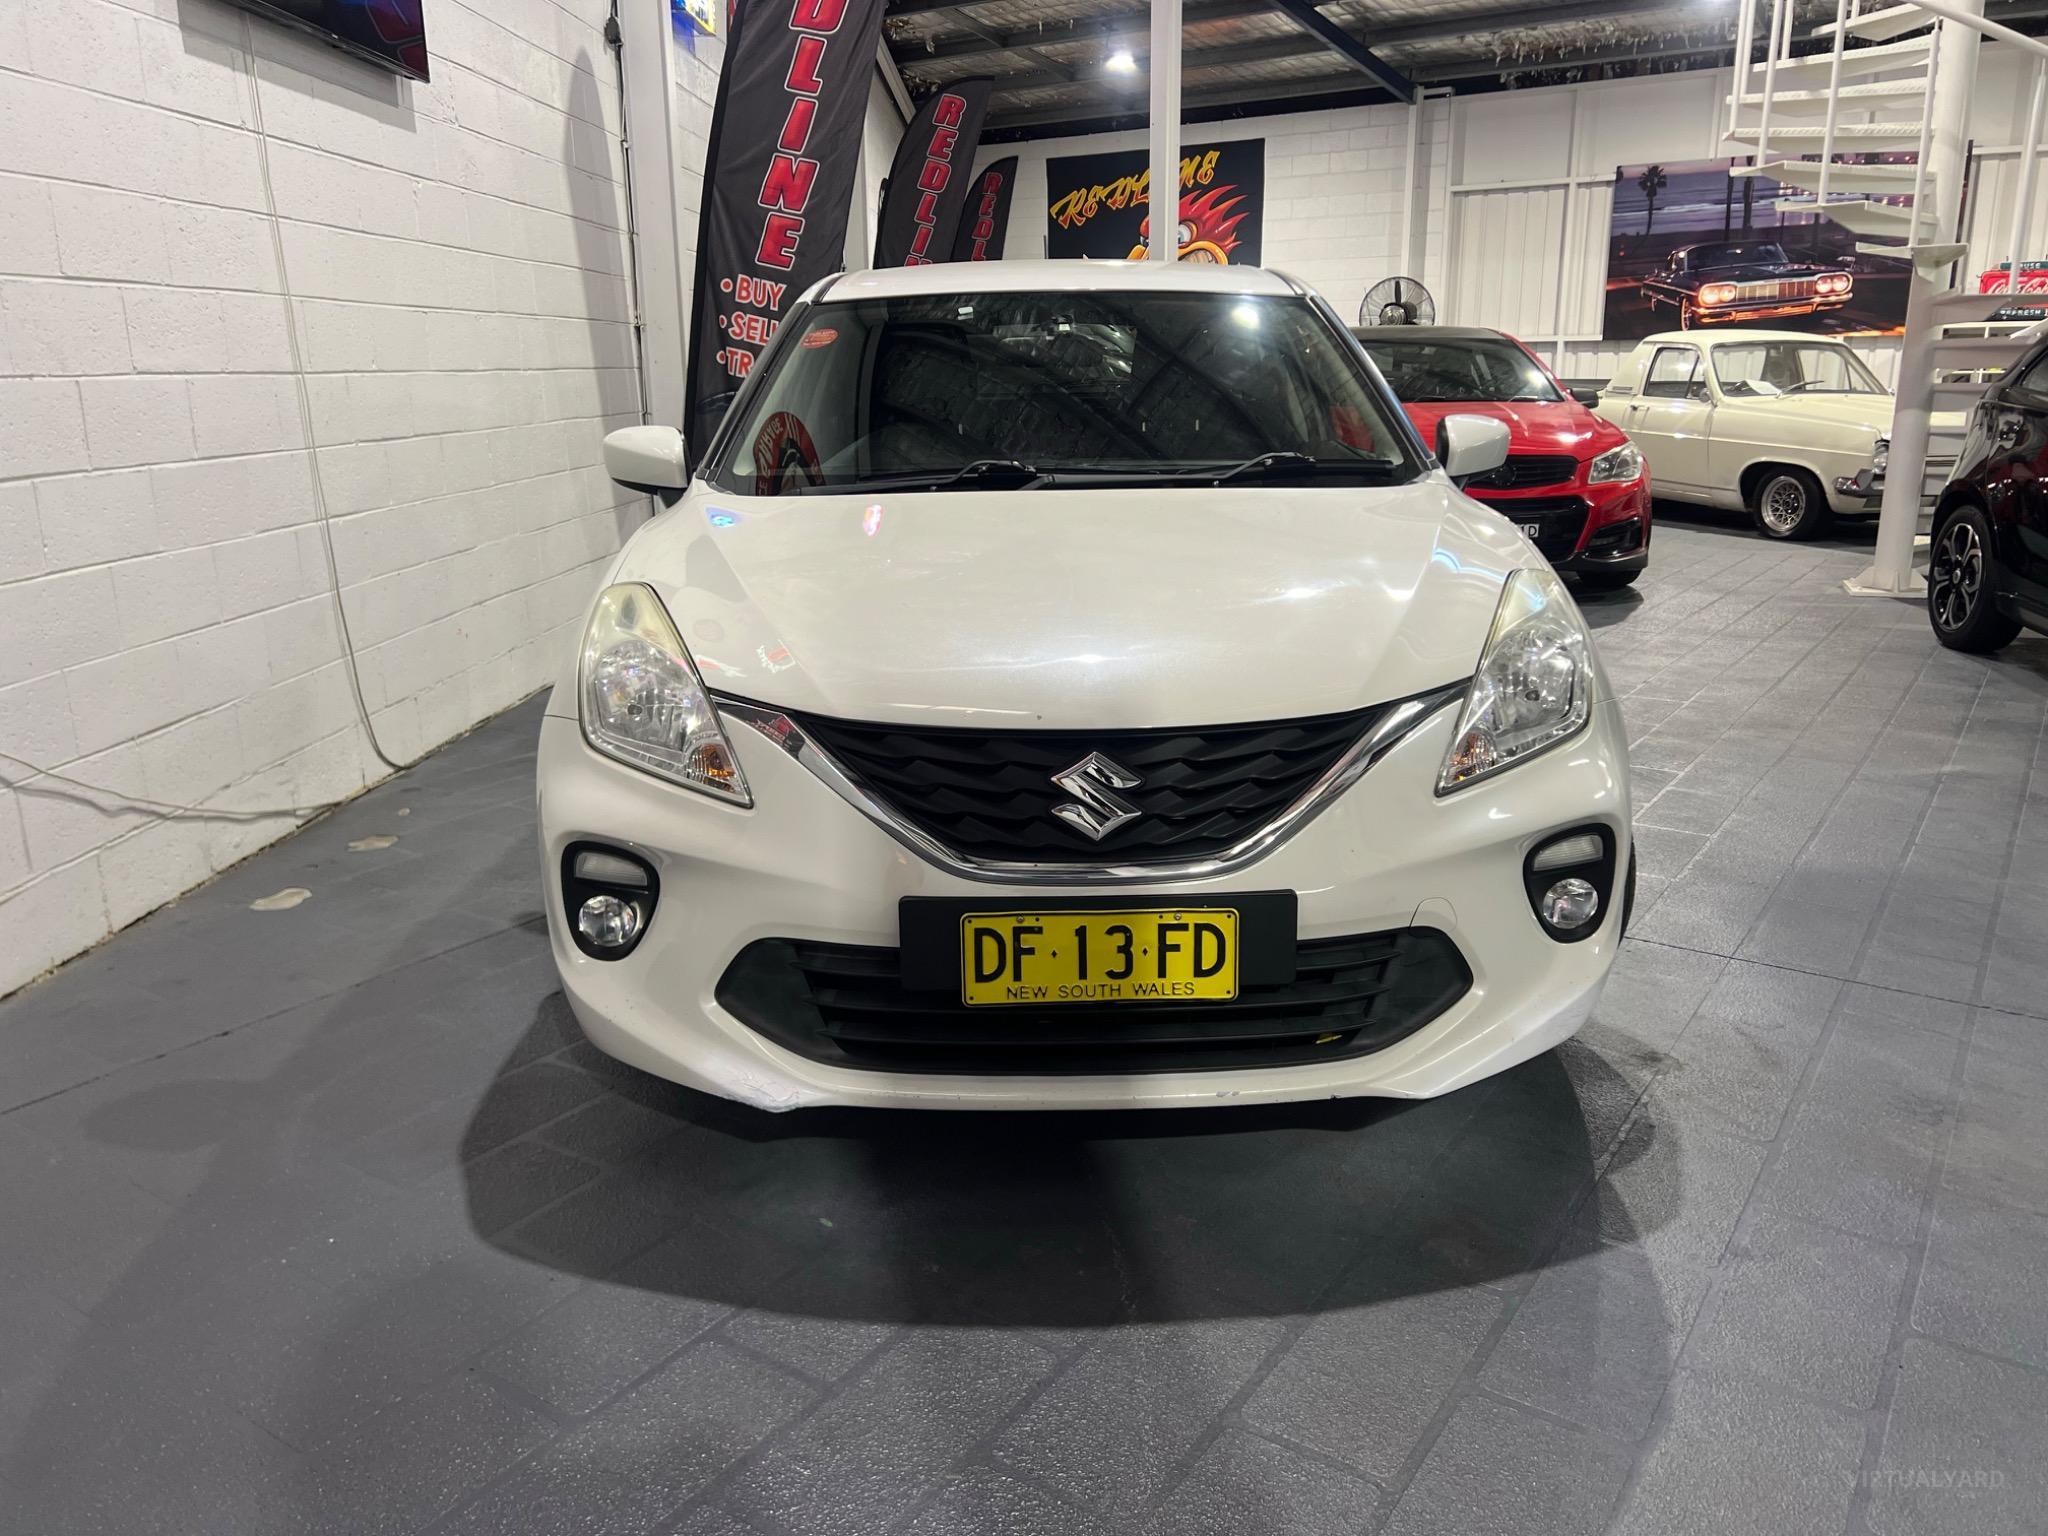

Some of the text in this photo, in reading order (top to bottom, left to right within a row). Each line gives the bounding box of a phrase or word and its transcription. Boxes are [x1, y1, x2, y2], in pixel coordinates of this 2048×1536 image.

[1050, 150, 1221, 229] REDLNE
[735, 274, 787, 311] BUY
[1074, 924, 1134, 981] 13
[1156, 922, 1227, 979] FD
[1006, 981, 1195, 999] NEW SOUTH WALES
